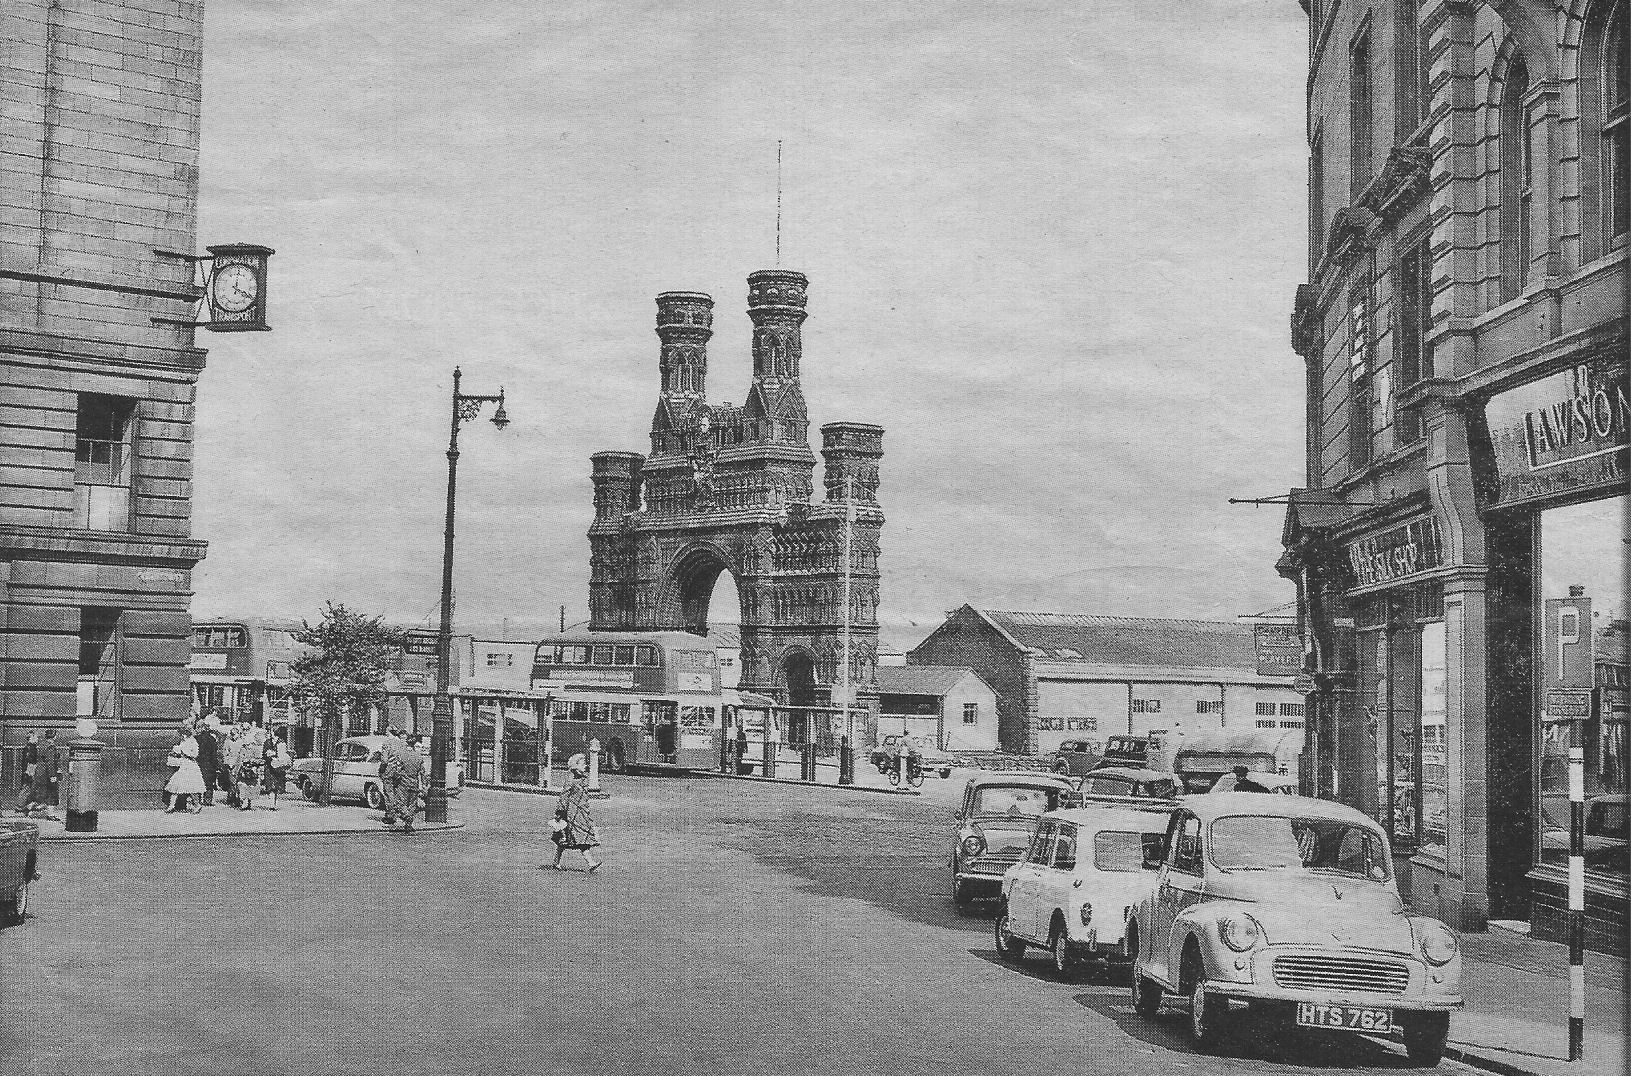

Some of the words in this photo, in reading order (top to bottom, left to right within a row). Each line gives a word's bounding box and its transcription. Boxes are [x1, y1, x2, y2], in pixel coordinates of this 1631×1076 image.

[1557, 606, 1580, 681] P
[1301, 1003, 1342, 1026] HTS
[1347, 1008, 1388, 1030] 762
